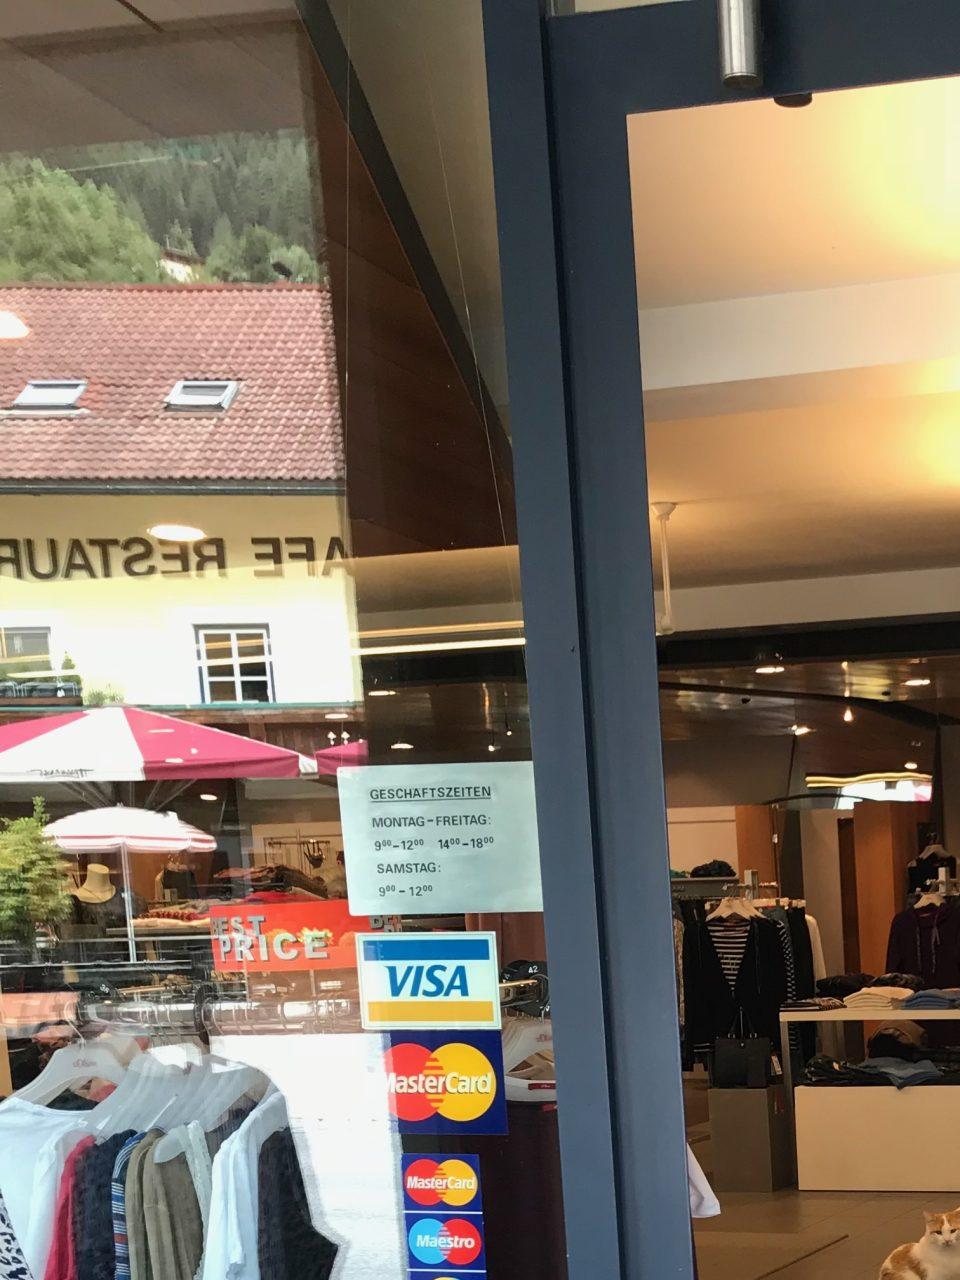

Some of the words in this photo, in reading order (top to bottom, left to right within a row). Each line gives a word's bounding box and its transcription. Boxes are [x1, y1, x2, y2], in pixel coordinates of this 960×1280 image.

[377, 862, 442, 874] SAMSTAG:
[219, 932, 329, 961] PRICE
[384, 964, 470, 998] VISA
[406, 1176, 475, 1189] MasterCard
[416, 1234, 475, 1249] Maestro
